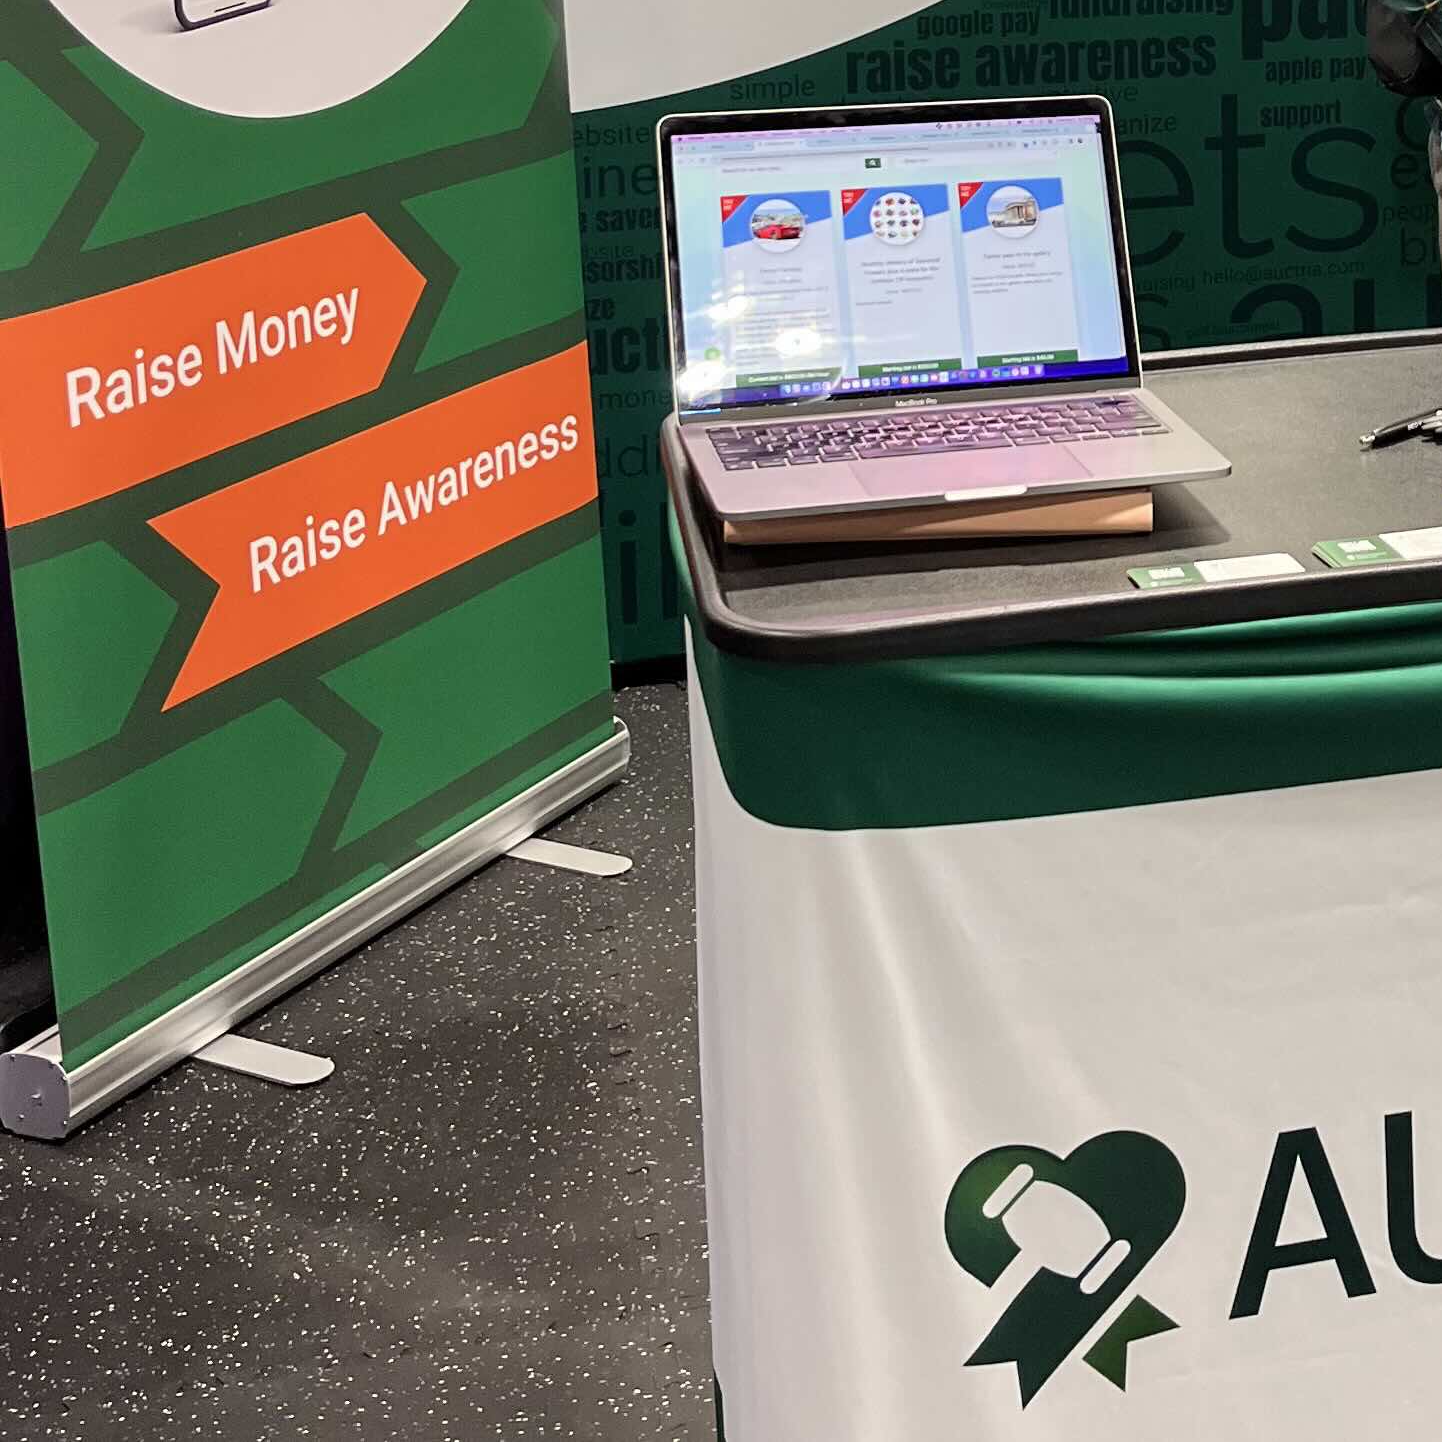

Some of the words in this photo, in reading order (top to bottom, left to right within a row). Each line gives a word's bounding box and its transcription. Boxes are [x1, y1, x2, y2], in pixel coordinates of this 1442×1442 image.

[917, 8, 994, 40] google
[1000, 6, 1040, 38] pay
[847, 40, 960, 95] raise
[976, 34, 1217, 88] awareness
[1266, 59, 1323, 85] apple
[1330, 56, 1366, 81] pay
[731, 74, 816, 102] simple
[1260, 101, 1342, 129] support
[65, 345, 203, 428] Raise
[215, 287, 360, 374] Money
[248, 505, 366, 594] Raise
[378, 414, 580, 535] Awareness
